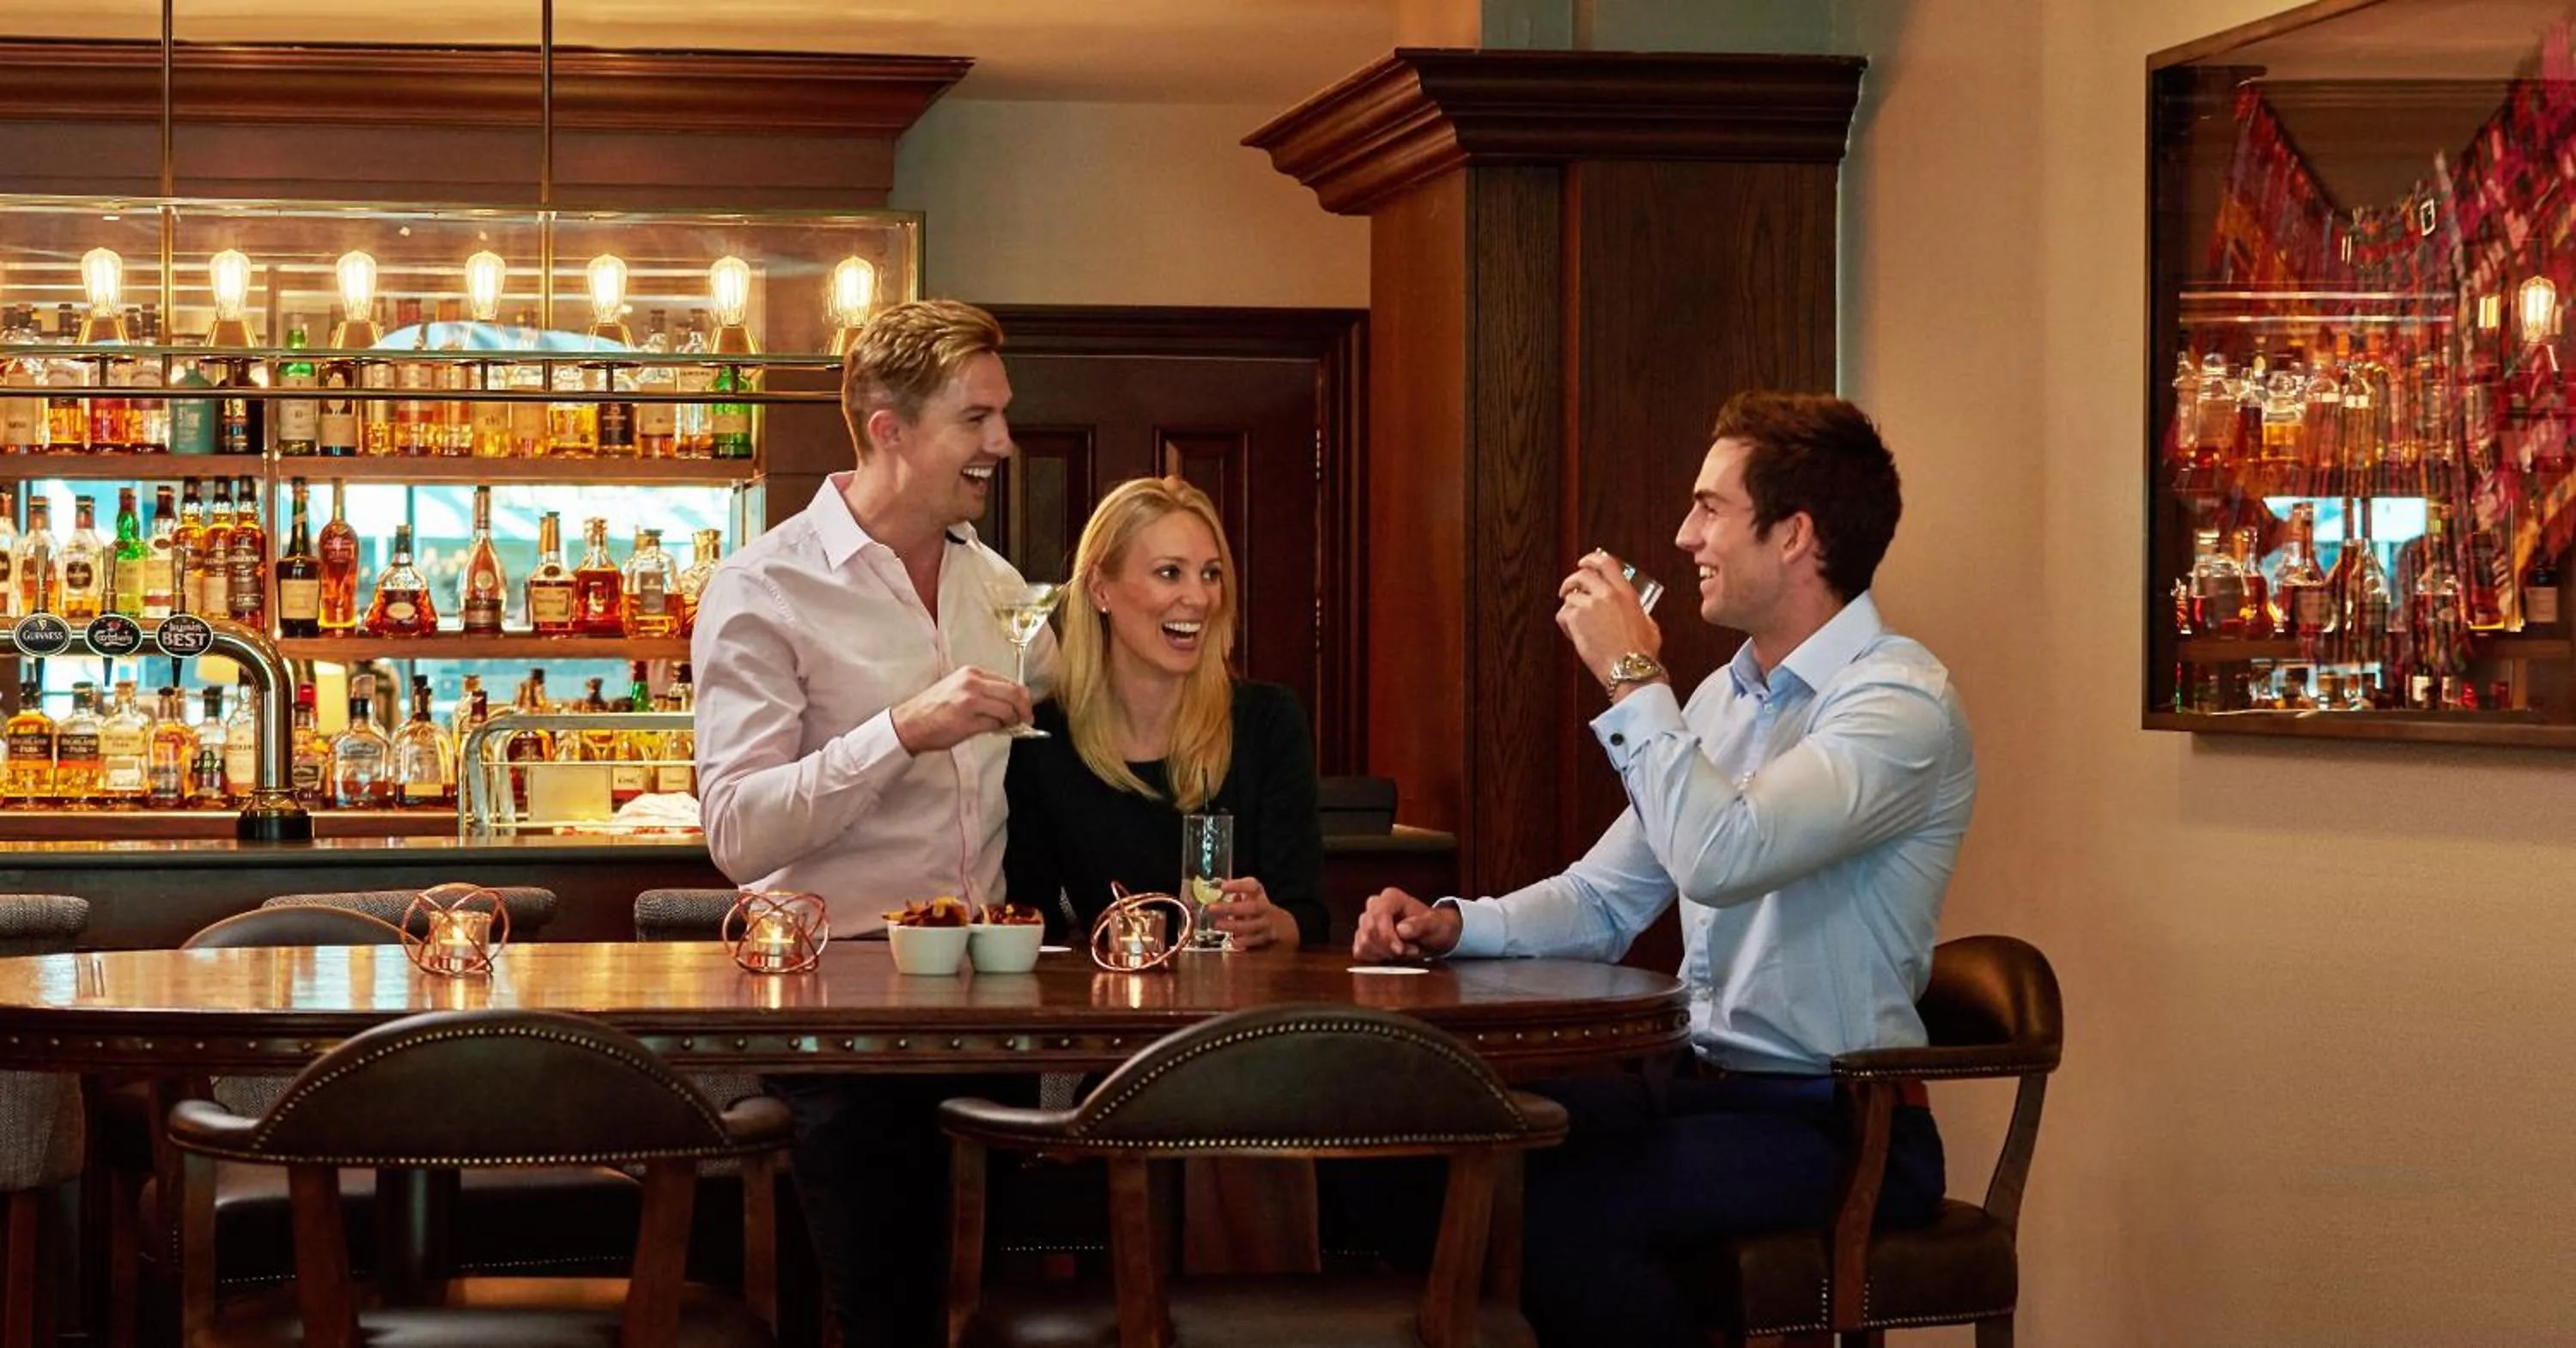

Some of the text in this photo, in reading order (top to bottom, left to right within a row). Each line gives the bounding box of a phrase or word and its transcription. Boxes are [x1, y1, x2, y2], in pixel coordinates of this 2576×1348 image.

[21, 629, 63, 641] GUINNESS
[94, 628, 133, 645] Carlsberg
[161, 632, 207, 647] BEST
